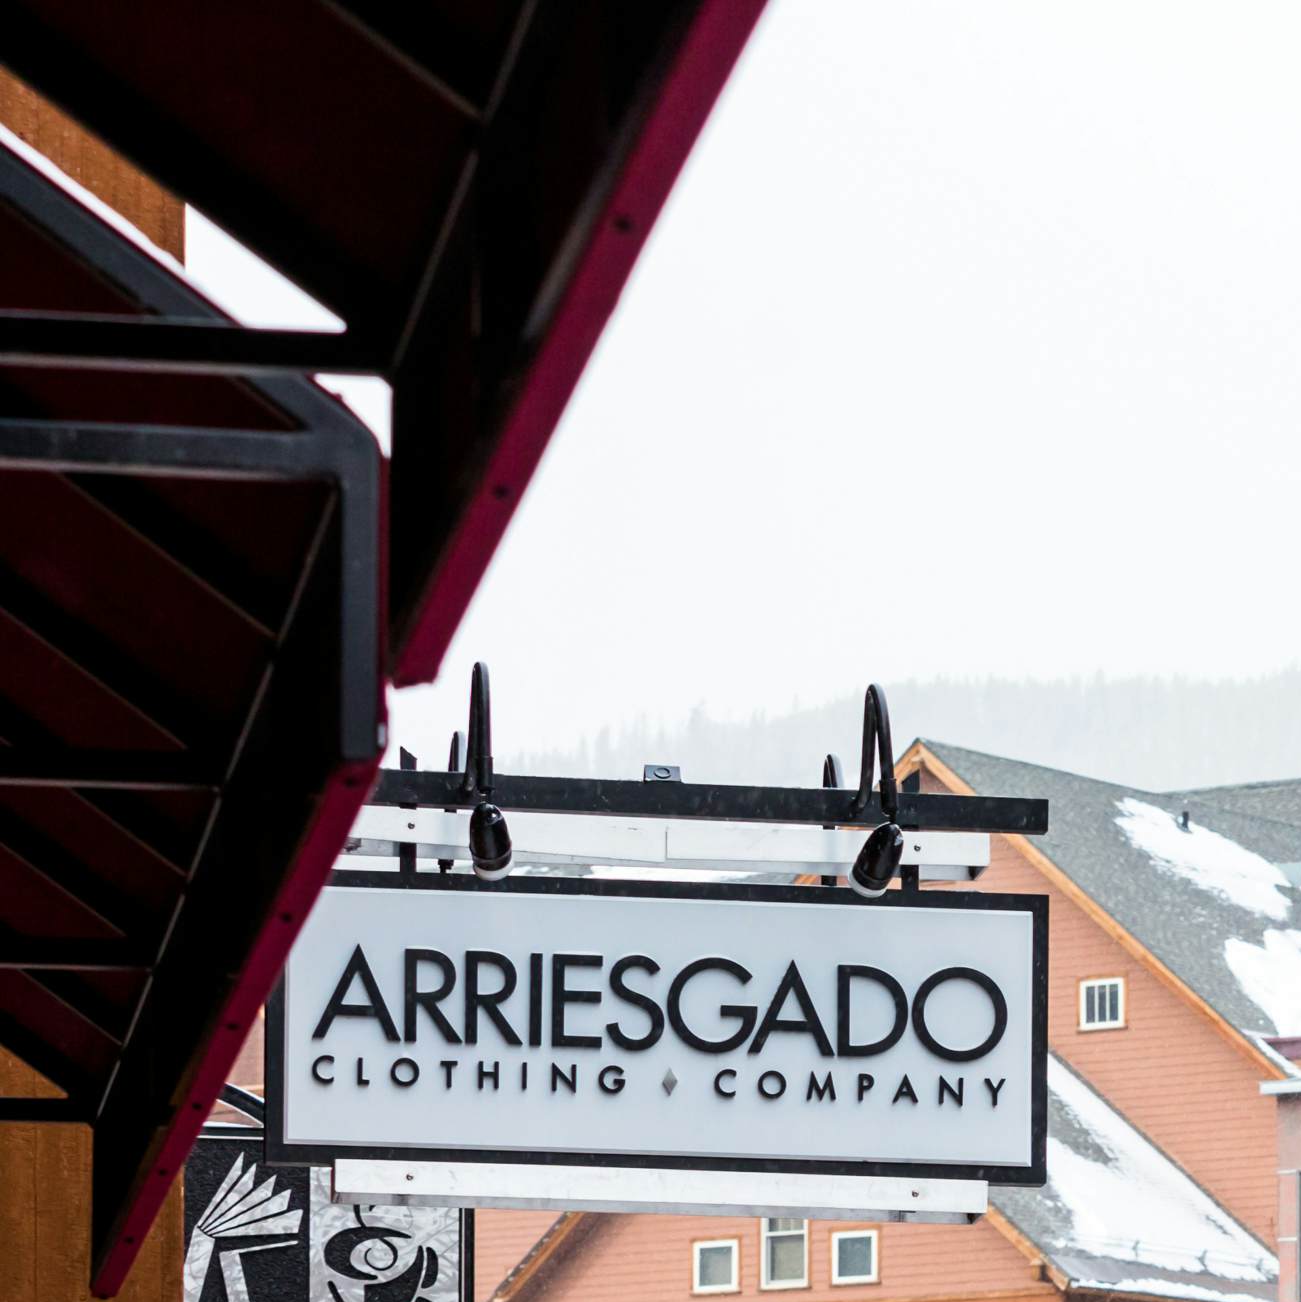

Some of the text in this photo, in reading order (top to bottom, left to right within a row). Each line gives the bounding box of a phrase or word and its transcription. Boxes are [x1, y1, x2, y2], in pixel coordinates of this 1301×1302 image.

[311, 944, 1009, 1062] ARRIESGADO
[311, 1055, 1008, 1109] CLOTHING COMPANY
